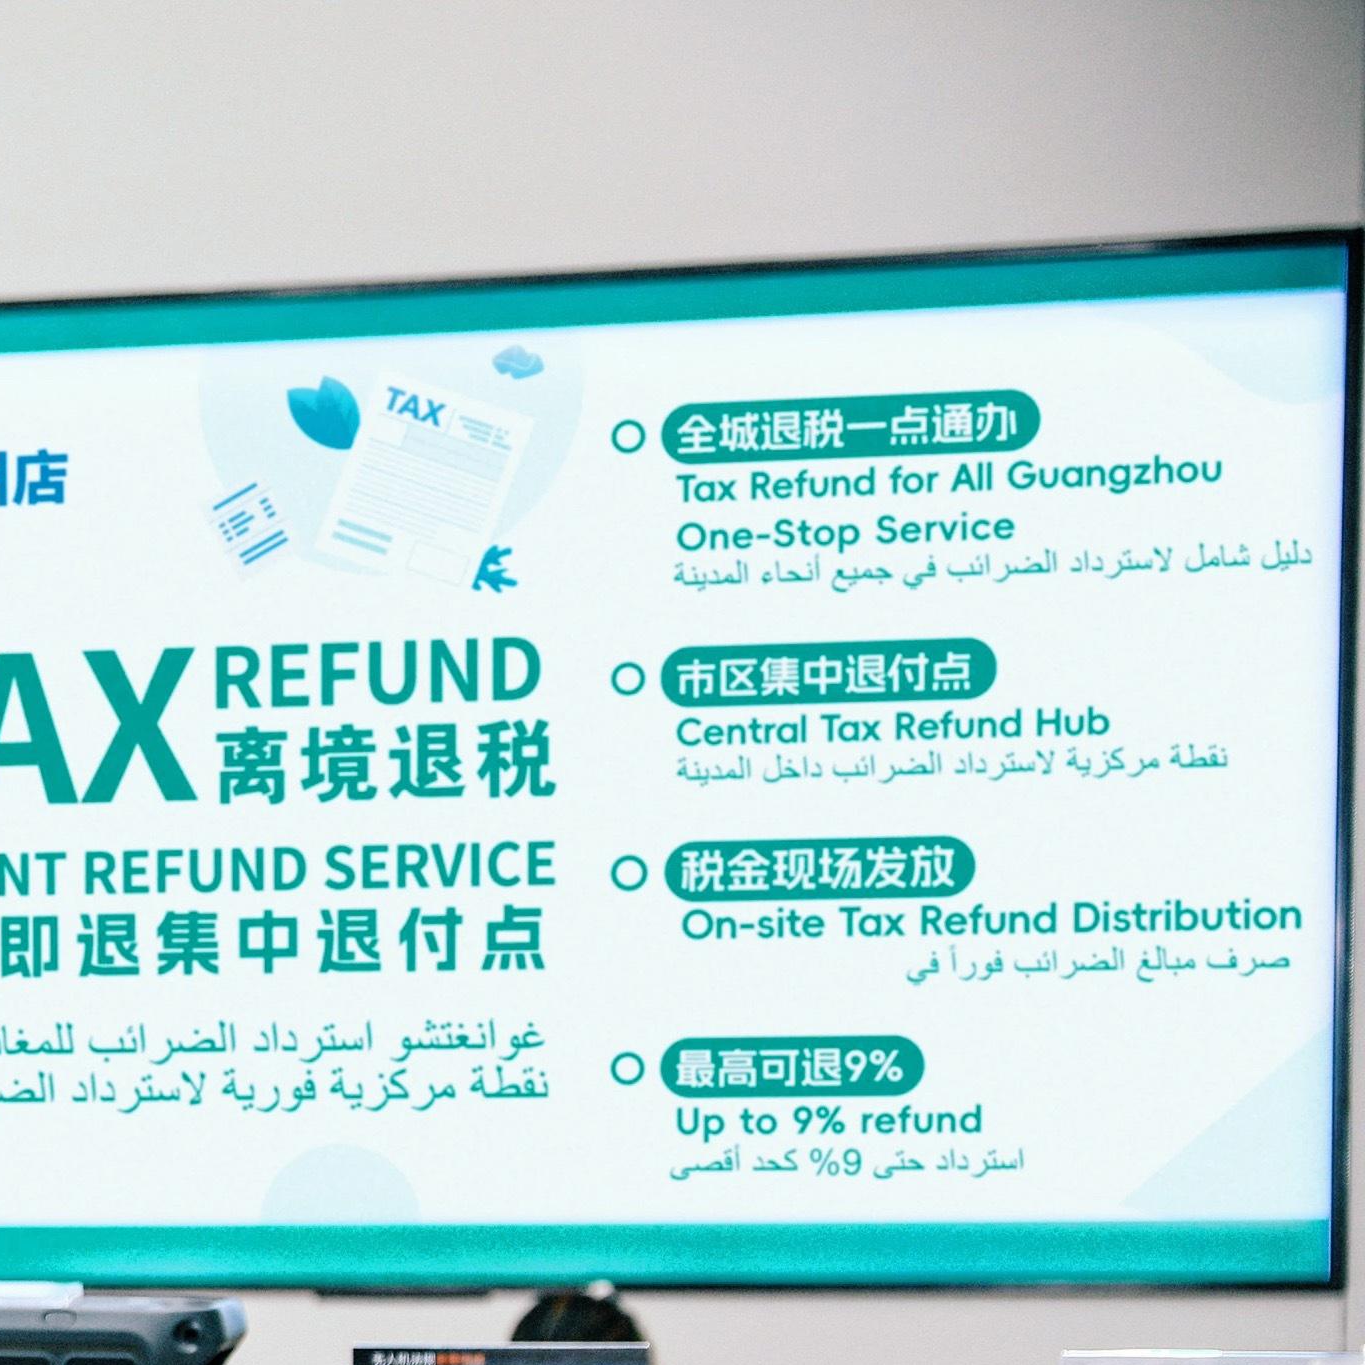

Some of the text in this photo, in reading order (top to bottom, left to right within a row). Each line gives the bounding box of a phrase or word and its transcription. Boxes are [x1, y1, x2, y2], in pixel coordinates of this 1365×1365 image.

[387, 386, 446, 427] TAX
[677, 402, 1017, 454] 全城退税一点通办
[675, 454, 1223, 503] Tax Refund for All Guangzhou
[676, 511, 1016, 555] One-Stop Service
[673, 559, 749, 592] المدينة
[902, 555, 938, 590] في
[946, 548, 1058, 584] الضرائب
[1069, 546, 1174, 580] لاسترداد
[1184, 542, 1251, 574] شامل
[1260, 539, 1313, 572] دليل
[831, 566, 894, 594] جميع
[215, 636, 542, 710] REFUND
[677, 652, 971, 698] 市区集中退付点
[676, 705, 1111, 748] Central Tax Refund Hub
[215, 718, 557, 806] 离境退税
[676, 743, 1228, 787] نقطة مركزية لاسترداد الضرائب داخل المدينة
[84, 846, 307, 896] REFUND
[324, 840, 556, 892] SERVICE
[681, 845, 955, 892] 税金现场发放
[681, 897, 1303, 941] On-site Tax Refund Distribution
[906, 951, 940, 986] في
[1013, 946, 1125, 980] الضرائب
[1136, 945, 1197, 984] مبالغ
[1206, 948, 1291, 977] صرف
[88, 1020, 236, 1066] الضرائب
[253, 1021, 373, 1065] استرداد
[393, 1019, 545, 1063] غوانغتشو
[469, 1065, 549, 1099] نقطة
[676, 1048, 903, 1088] 最高可退9%
[71, 1071, 207, 1115] لاسترداد
[221, 1067, 317, 1114] فورية
[329, 1067, 457, 1113] مركزية
[676, 1103, 982, 1144] Up to 9% refund
[935, 1148, 1025, 1179] استرداد
